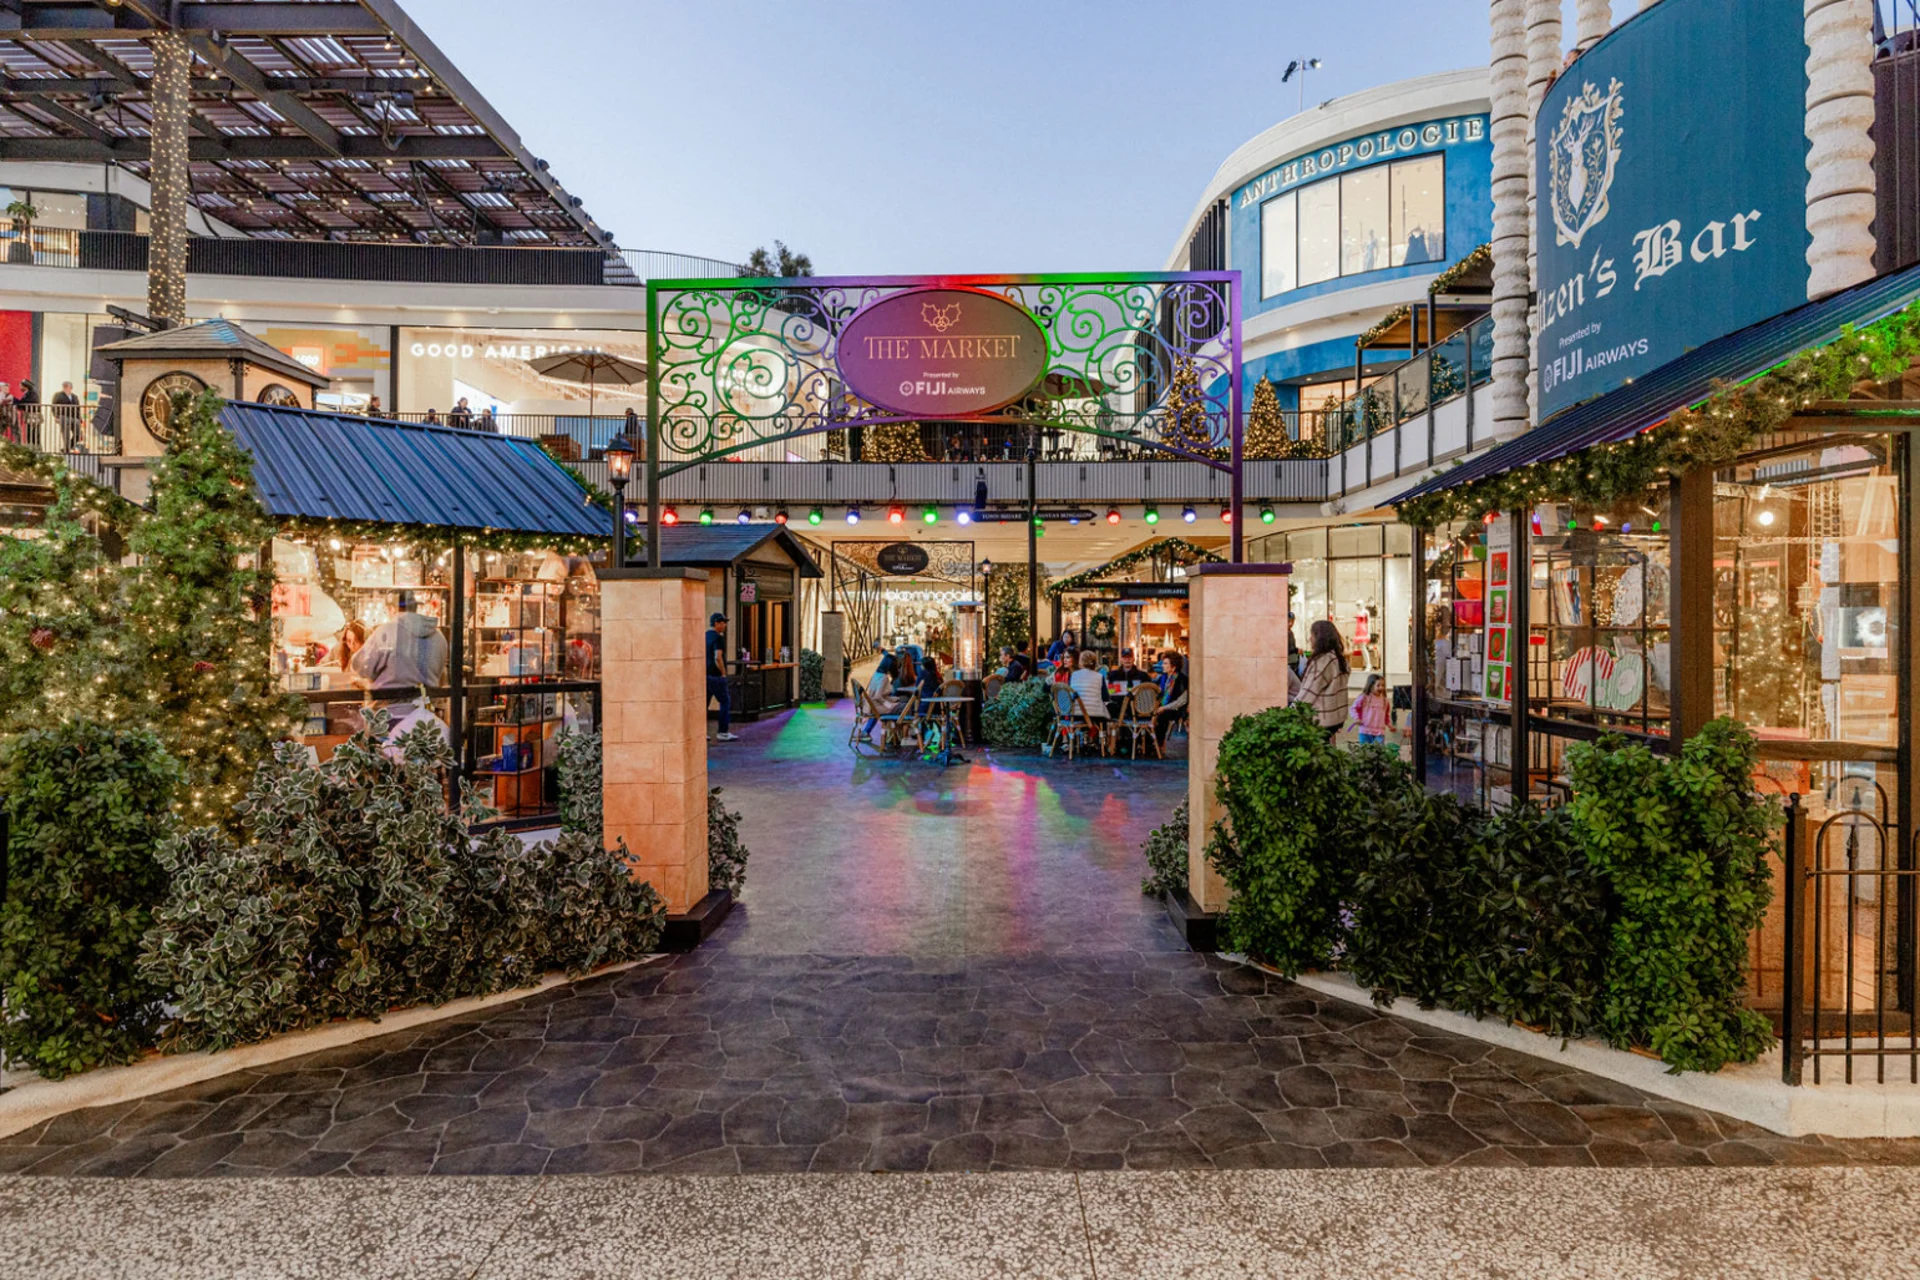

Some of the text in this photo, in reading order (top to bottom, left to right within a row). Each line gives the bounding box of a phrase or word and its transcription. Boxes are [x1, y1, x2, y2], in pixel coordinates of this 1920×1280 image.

[1239, 118, 1484, 209] ANTHROPOLOGIE
[1632, 209, 1762, 291] Bar
[864, 335, 1021, 360] THE MARKET
[1559, 322, 1602, 348] Presented by
[410, 343, 473, 359] GOOD
[1553, 338, 1649, 386] FIJI AIRWAYS
[923, 371, 960, 380] Presented by
[915, 381, 986, 396] FIJI AIRWAYS
[886, 588, 982, 604] bloomingdales
